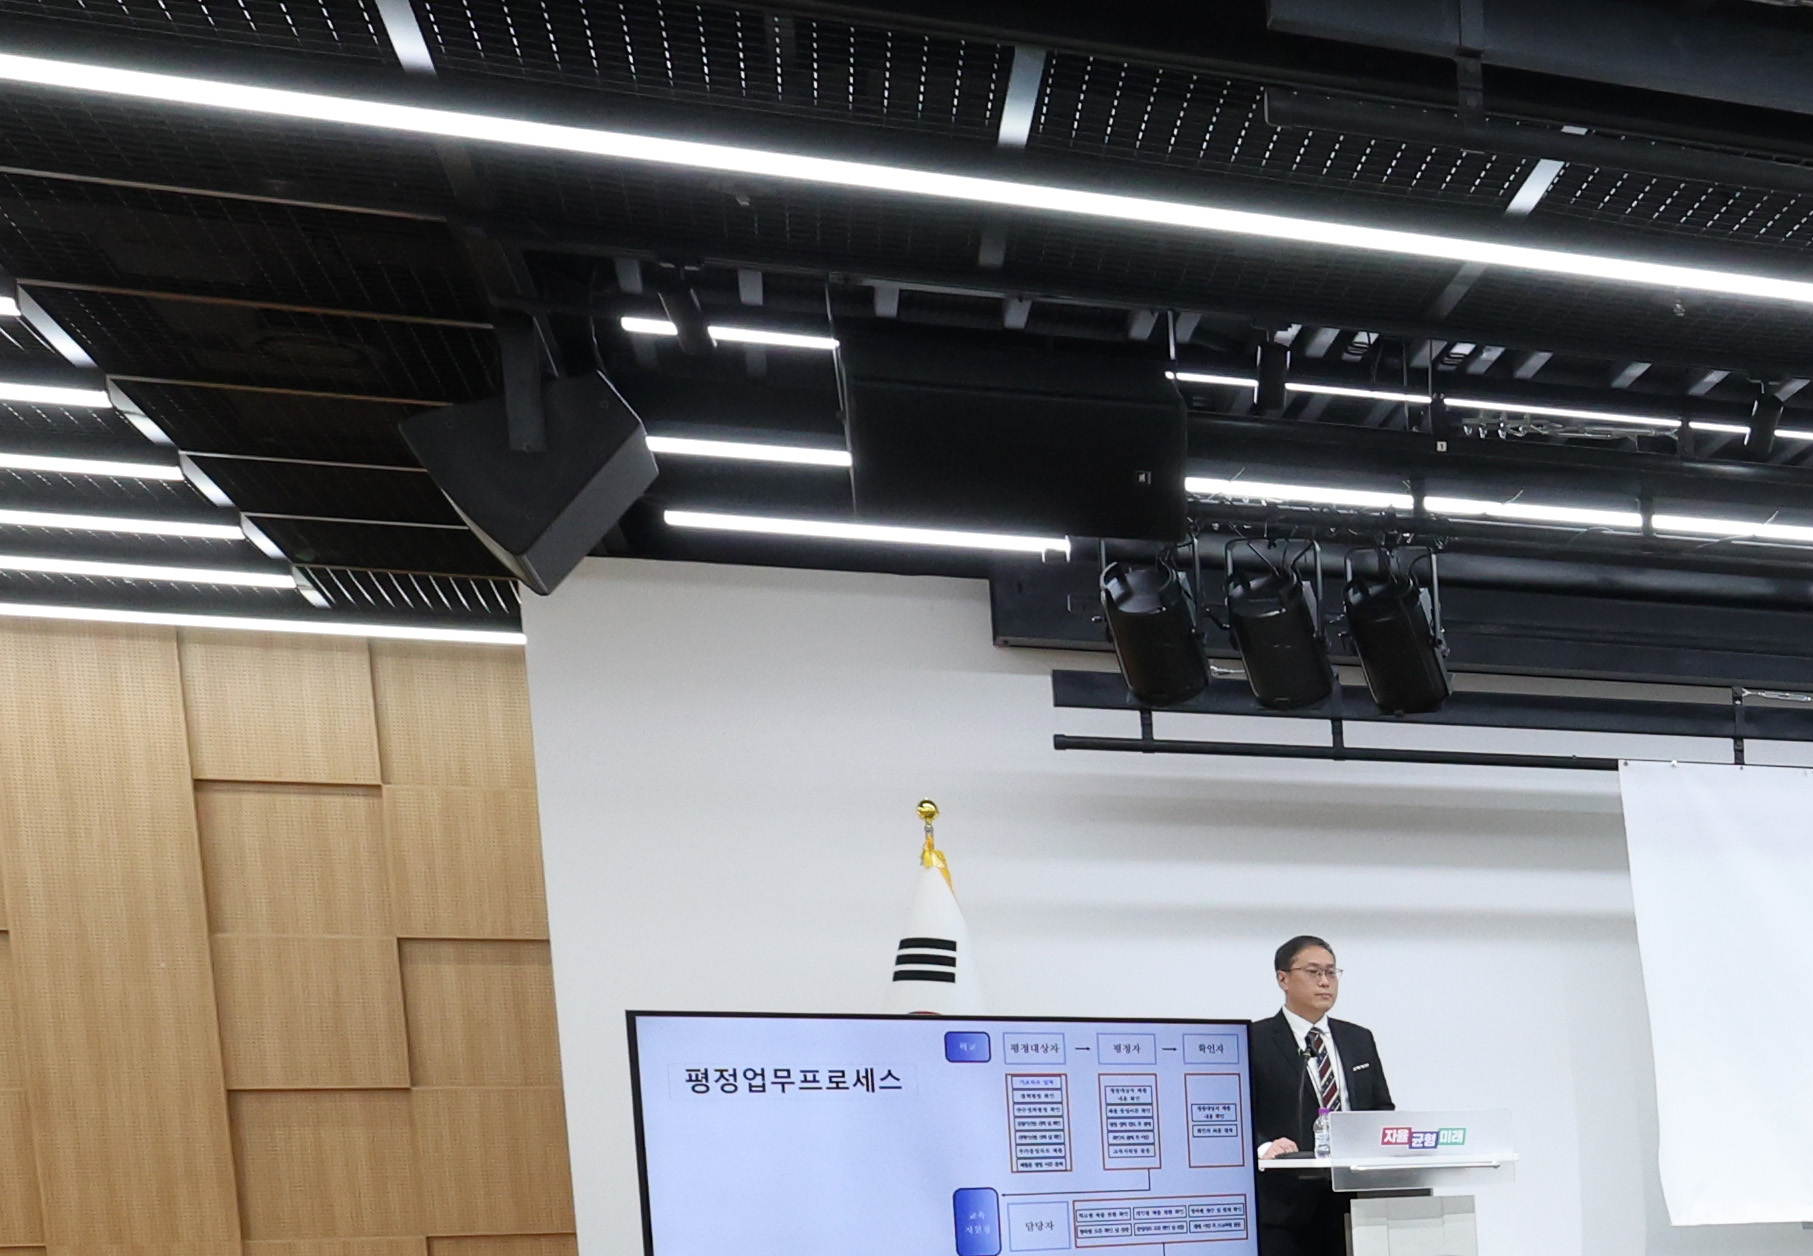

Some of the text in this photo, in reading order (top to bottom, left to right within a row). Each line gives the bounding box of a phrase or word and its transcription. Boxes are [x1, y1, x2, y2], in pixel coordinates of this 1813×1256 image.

[1011, 1043, 1059, 1053] 평정대상자
[1113, 1044, 1141, 1054] 평정자
[1198, 1044, 1224, 1054] 확인자
[684, 1066, 902, 1094] 평정업무프로세스
[1384, 1129, 1464, 1147] 자율 균형 미래
[1025, 1220, 1054, 1231] 담당자
